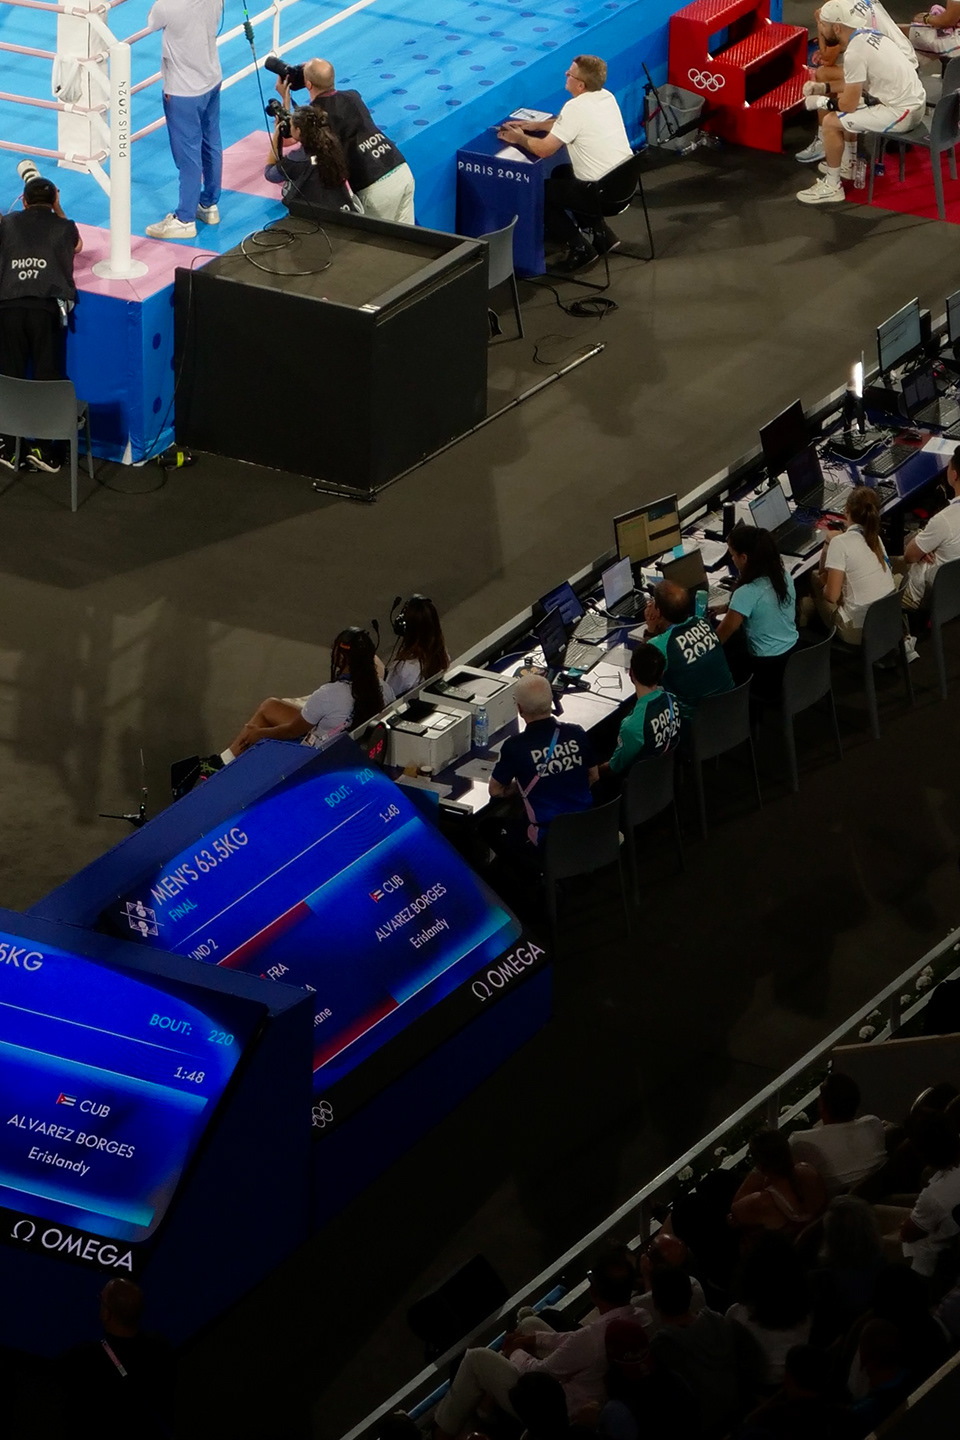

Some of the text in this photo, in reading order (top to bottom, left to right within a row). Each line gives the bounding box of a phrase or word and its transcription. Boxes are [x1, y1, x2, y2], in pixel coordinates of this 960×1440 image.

[118, 81, 127, 115] 2024
[371, 143, 392, 159] 094
[497, 168, 530, 183] 2024
[11, 258, 47, 269] PHOTO
[18, 269, 39, 281] 097
[683, 632, 720, 665] 2024
[535, 754, 583, 778] 2024
[324, 768, 375, 808] BOUT: 220
[378, 803, 401, 824] 1:48
[150, 826, 249, 907] MEN'S 63.5KG
[382, 874, 404, 894] CUB
[168, 897, 198, 923] FINAL
[374, 882, 448, 943] ALVAREZ BORGES
[207, 938, 219, 950] 2
[409, 917, 450, 950] Erislandy
[267, 962, 290, 982] FRA
[486, 940, 546, 990] OMEGA
[149, 1013, 234, 1046] BOUT: 220
[173, 1066, 206, 1084] 1:48
[79, 1100, 111, 1119] CUB
[7, 1114, 136, 1160] ALVAREZ BORGES
[28, 1146, 91, 1177] Erislandy
[41, 1228, 133, 1272] OMEGA
